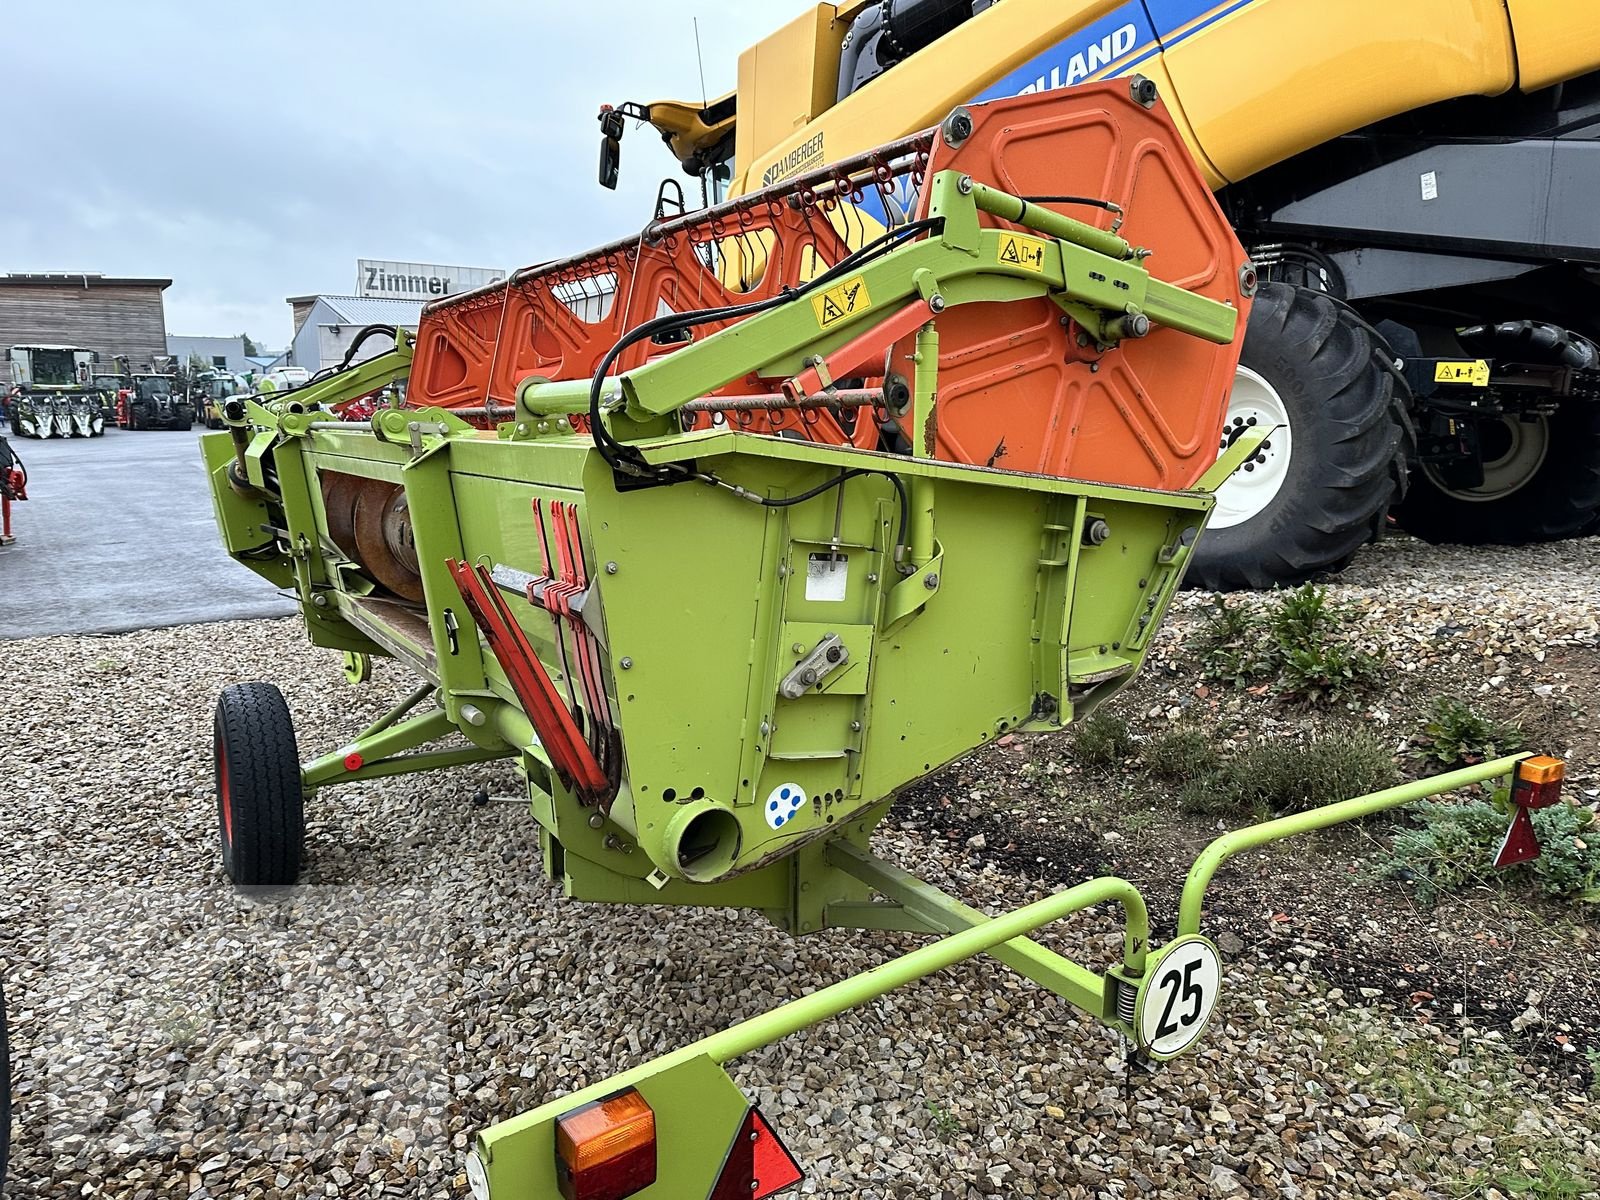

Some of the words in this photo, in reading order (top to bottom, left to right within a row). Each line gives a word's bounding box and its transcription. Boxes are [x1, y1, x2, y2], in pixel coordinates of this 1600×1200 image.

[771, 131, 824, 185] PAMBERGER
[364, 267, 450, 294] Zimmer
[1155, 958, 1203, 1040] 25
